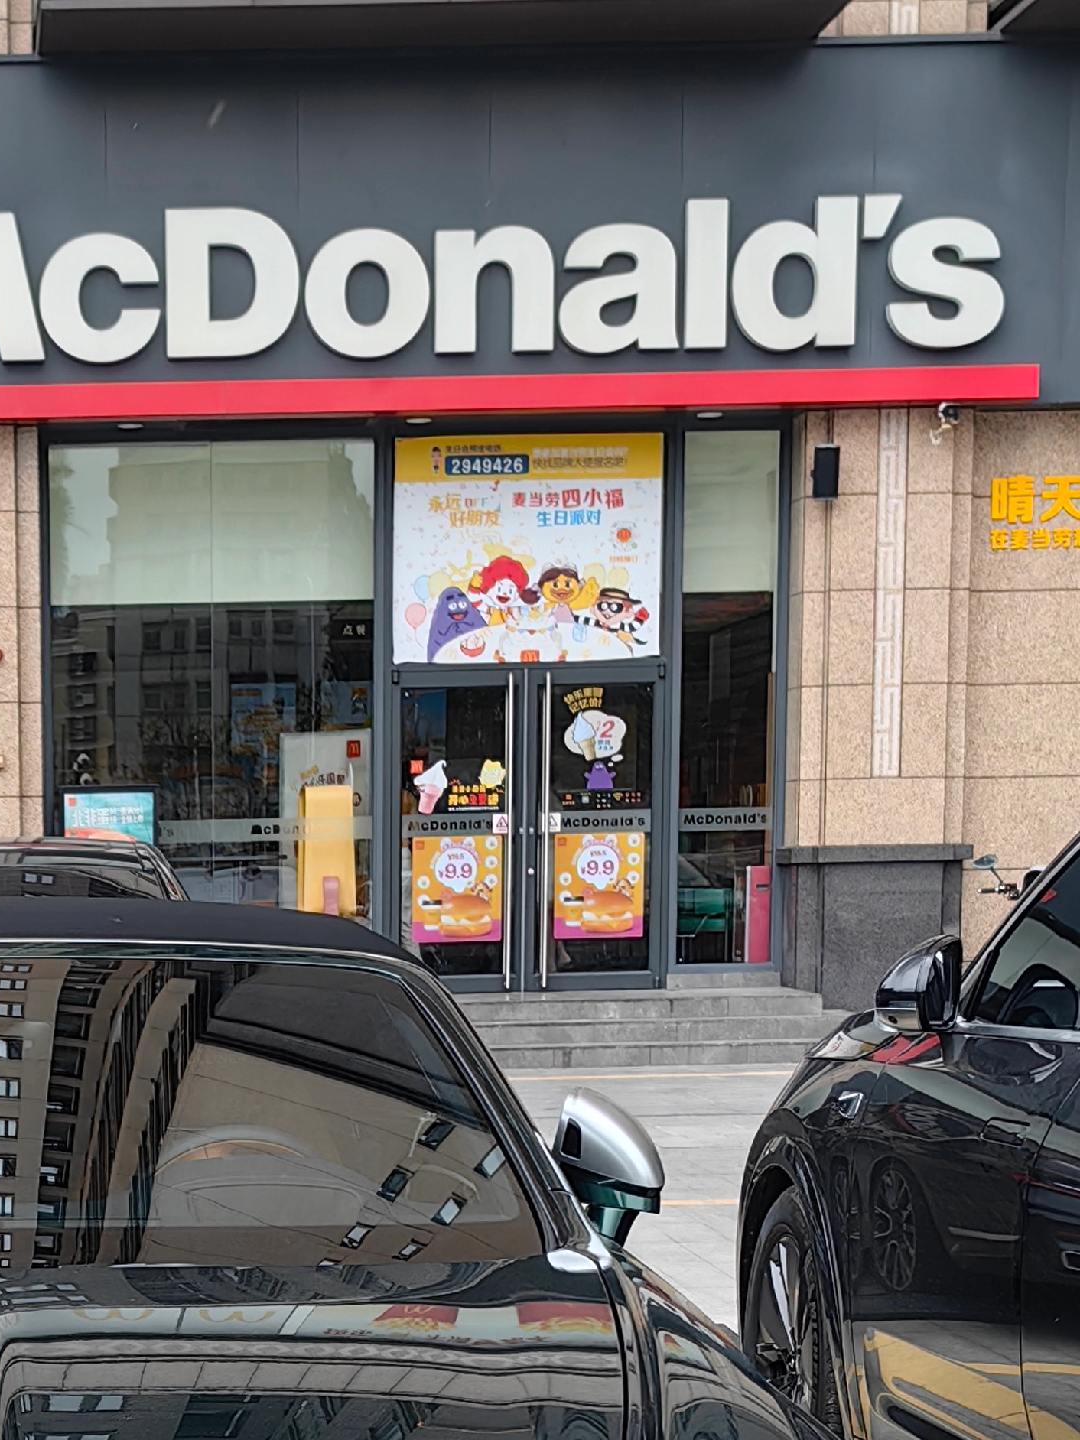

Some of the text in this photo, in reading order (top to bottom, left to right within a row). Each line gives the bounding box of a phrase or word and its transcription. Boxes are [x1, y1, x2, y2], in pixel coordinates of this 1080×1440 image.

[451, 457, 524, 474] 2949426
[990, 474, 1080, 524] 晴天
[536, 509, 601, 527] 生日派对
[562, 816, 646, 828] McDonald's
[683, 812, 767, 825] McDonald's
